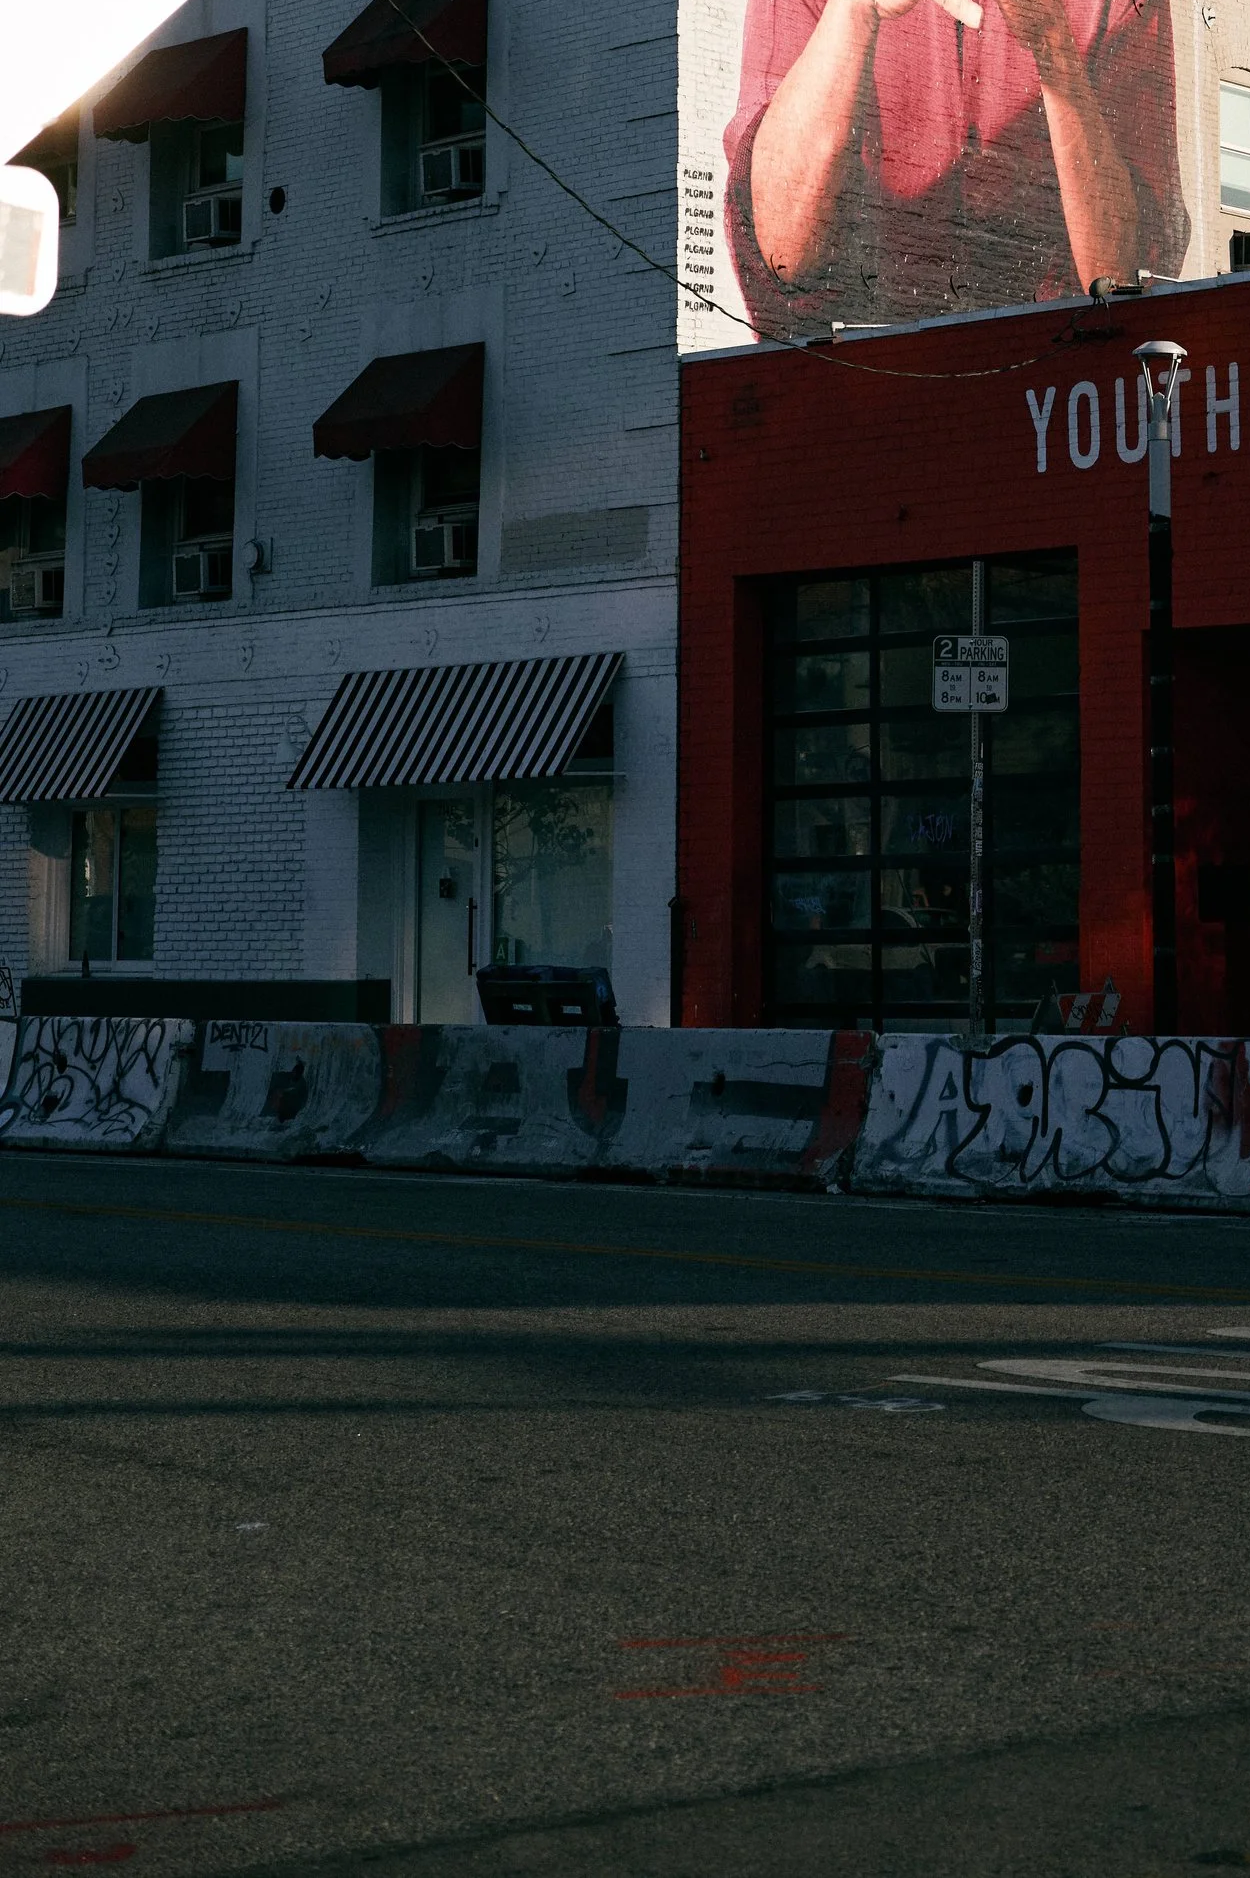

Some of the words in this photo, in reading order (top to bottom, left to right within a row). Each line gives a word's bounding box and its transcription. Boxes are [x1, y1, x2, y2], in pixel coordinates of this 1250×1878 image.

[1025, 361, 1240, 473] YOUTH
[940, 639, 953, 658] 2
[971, 639, 994, 647] HOUR
[960, 646, 1004, 661] PARKING
